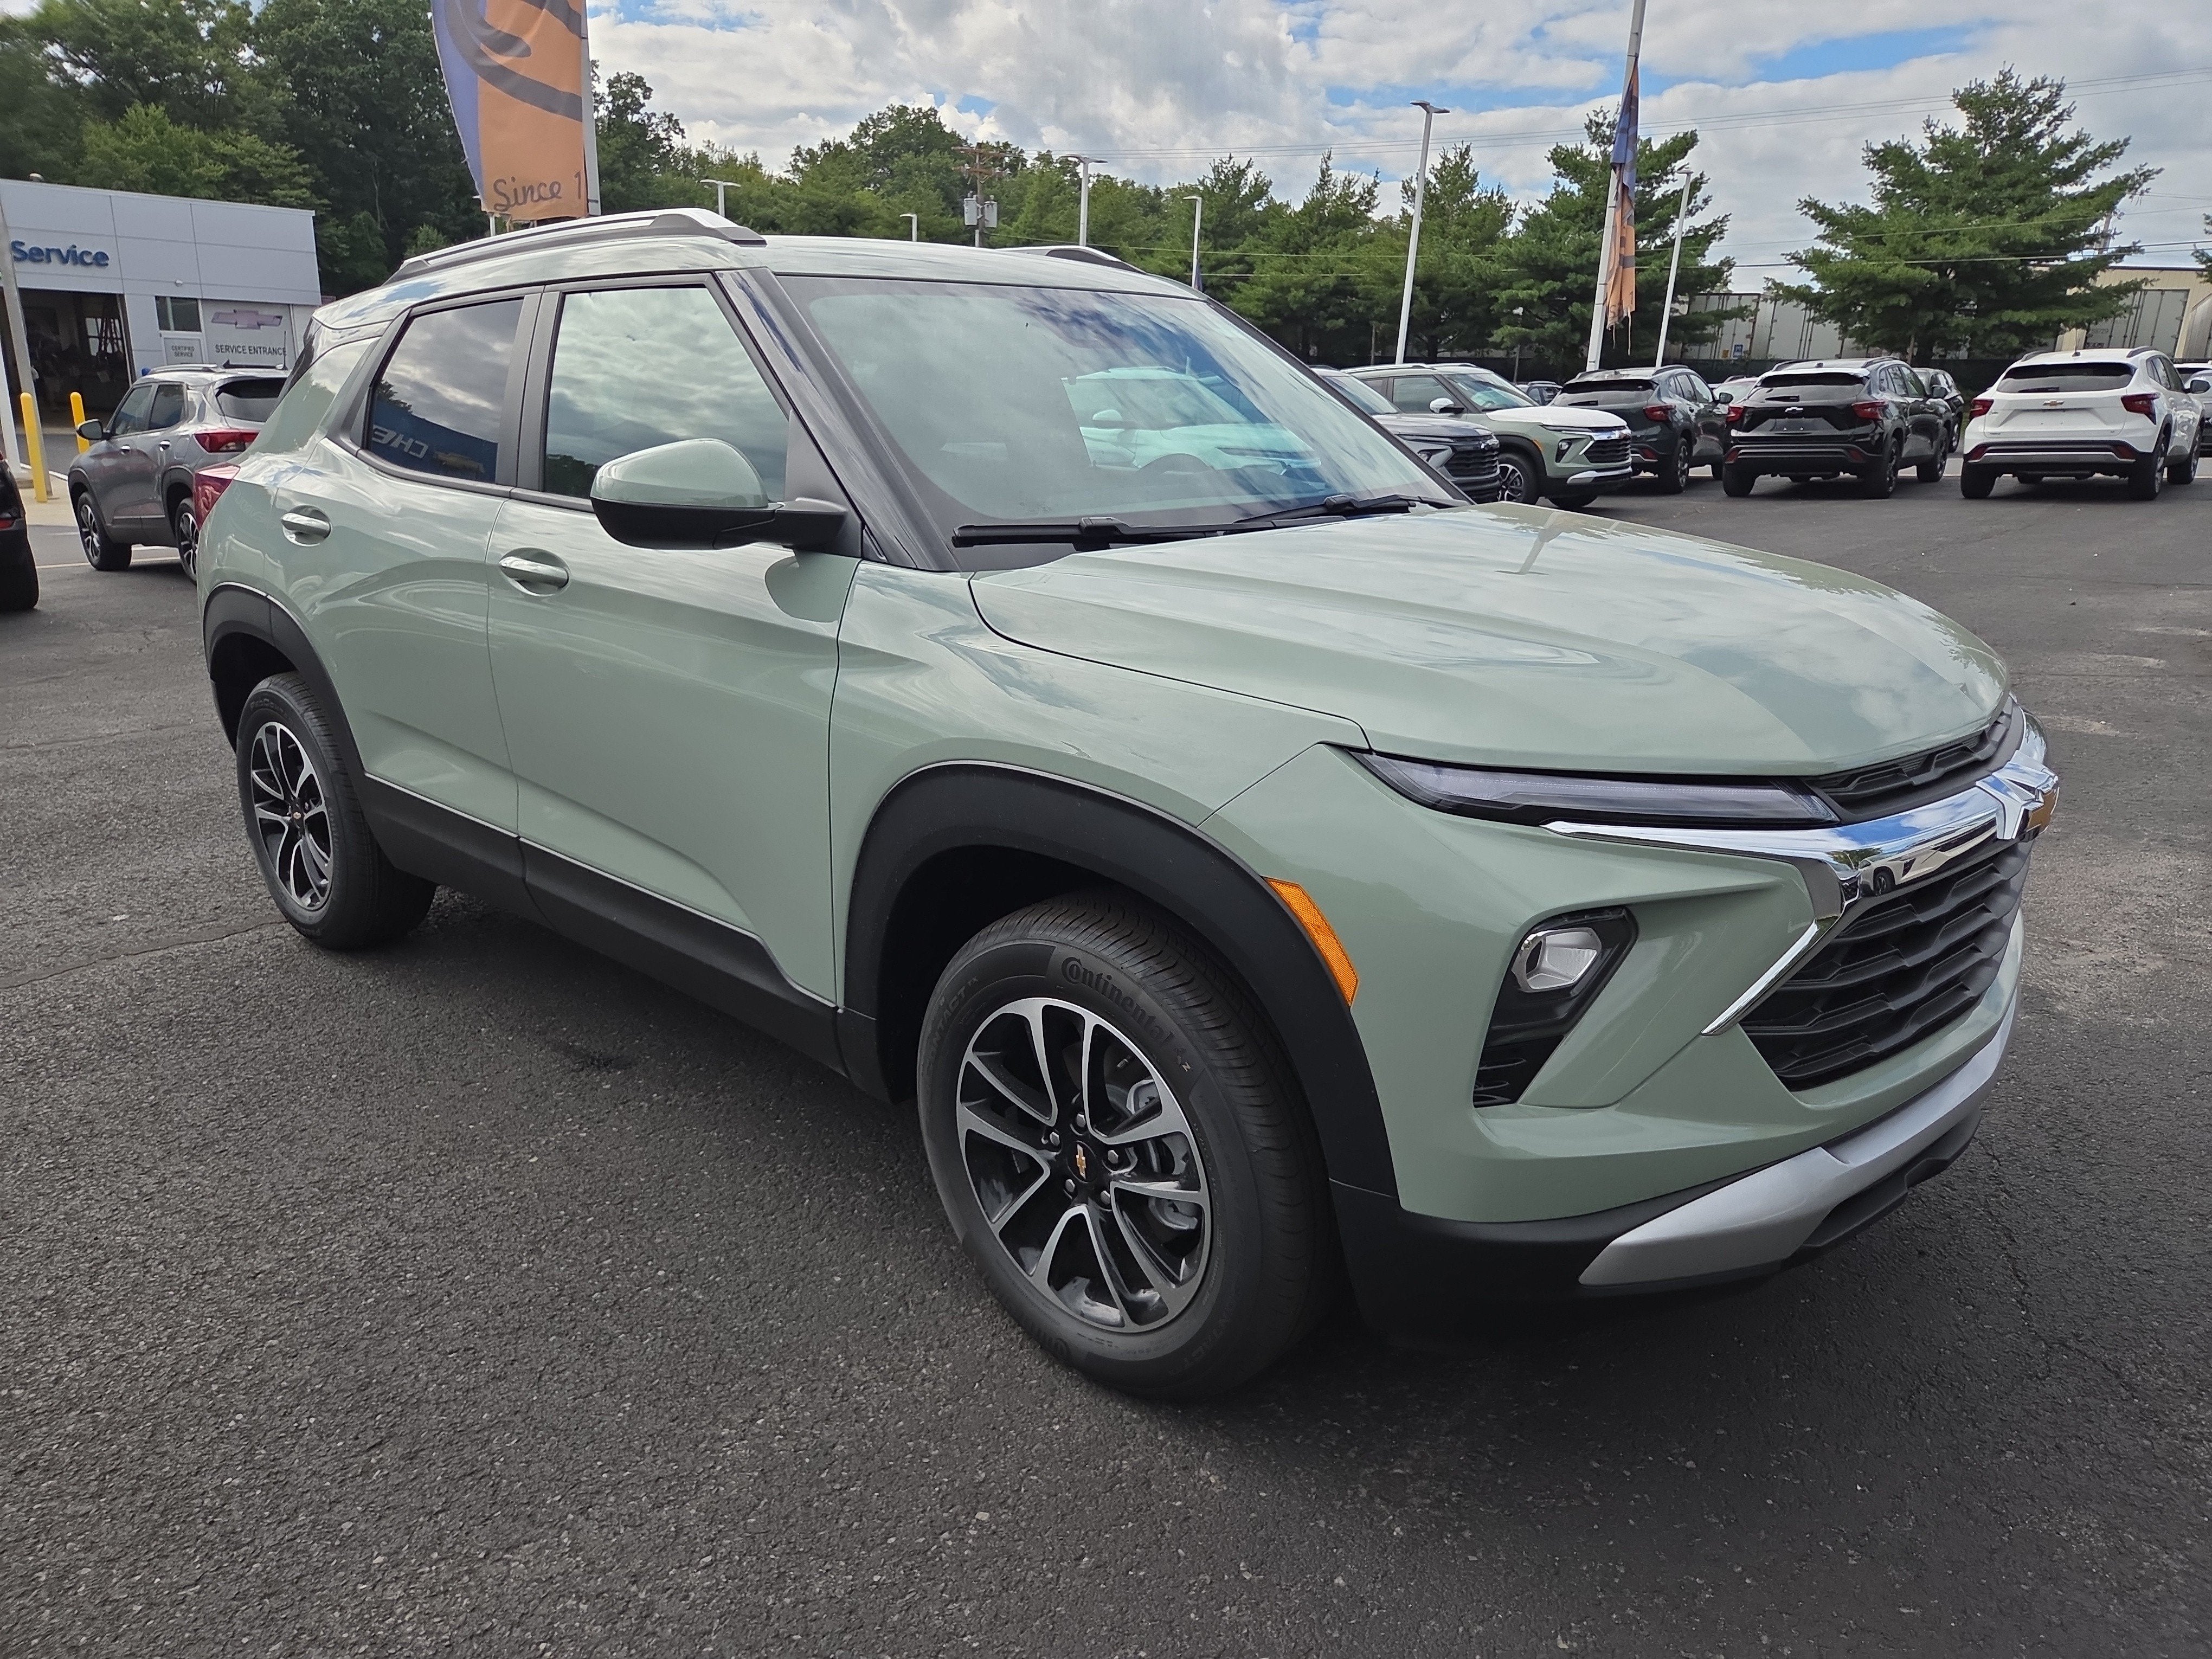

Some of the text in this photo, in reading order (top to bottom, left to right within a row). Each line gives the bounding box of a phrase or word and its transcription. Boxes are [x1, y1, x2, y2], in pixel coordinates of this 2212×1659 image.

[493, 176, 562, 211] Since
[11, 240, 110, 266] Service
[215, 344, 286, 356] SERVICE ENTRANCE
[1061, 956, 1175, 1046] Continental
